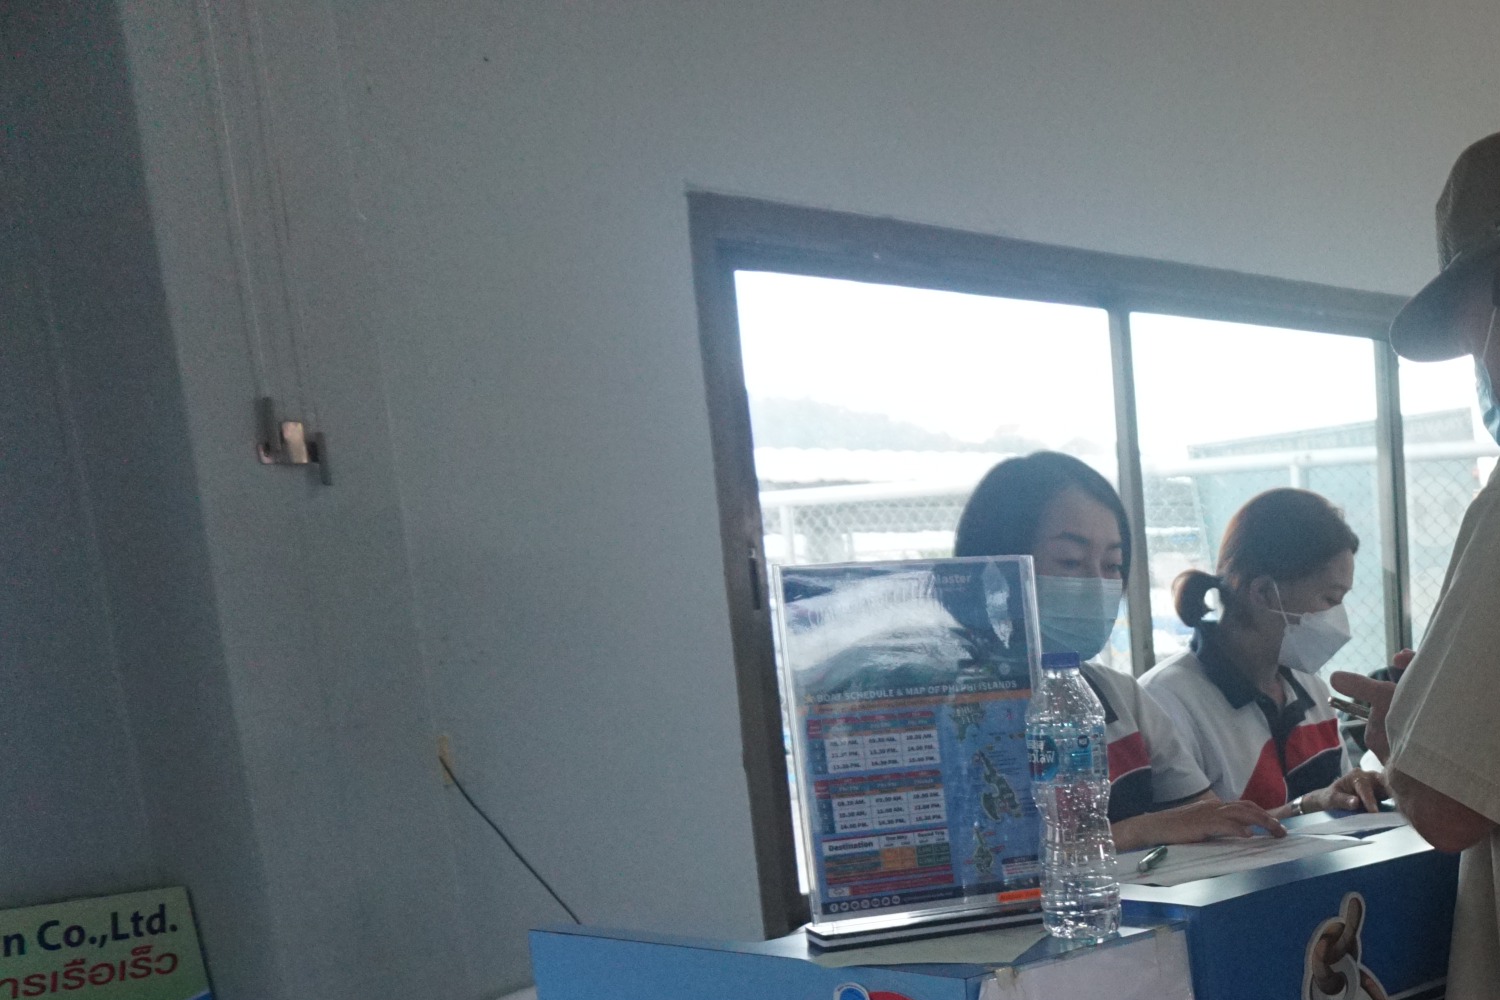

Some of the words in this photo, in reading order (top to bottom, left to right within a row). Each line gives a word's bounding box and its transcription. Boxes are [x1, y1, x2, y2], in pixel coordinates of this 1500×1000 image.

[844, 688, 894, 700] SCHEDULE
[905, 685, 925, 696] MAP
[928, 684, 940, 694] OF
[979, 679, 1018, 691] ISLANDS
[828, 840, 874, 852] Destination
[38, 903, 179, 950] Co.,Ltd.
